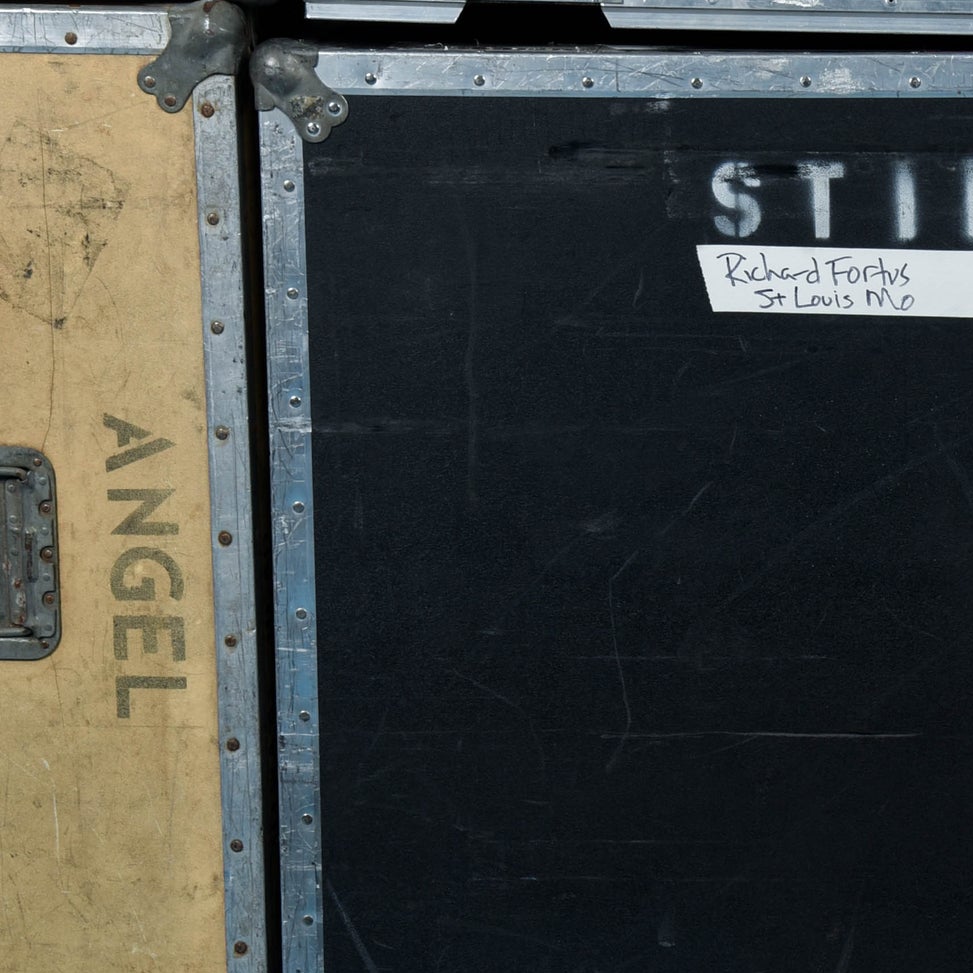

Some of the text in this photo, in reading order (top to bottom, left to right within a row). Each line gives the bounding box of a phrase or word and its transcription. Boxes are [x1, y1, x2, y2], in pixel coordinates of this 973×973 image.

[716, 252, 820, 287] Richard
[754, 288, 786, 310] St
[794, 286, 854, 309] Louis
[103, 412, 188, 719] ANGEL
